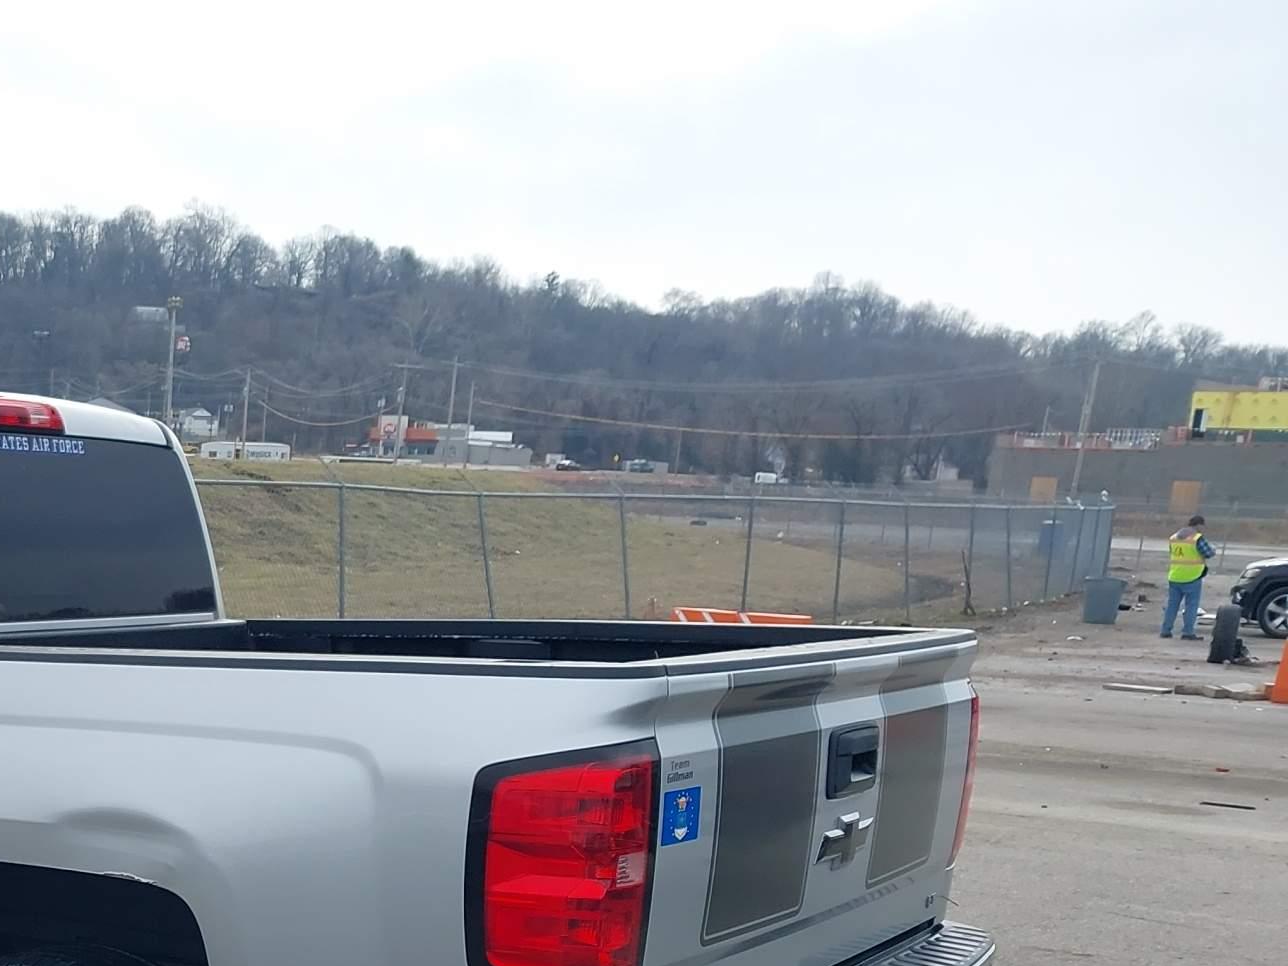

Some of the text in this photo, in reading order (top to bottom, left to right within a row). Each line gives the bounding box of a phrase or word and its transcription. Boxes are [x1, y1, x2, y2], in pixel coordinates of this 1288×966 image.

[32, 437, 51, 452] AIR
[53, 439, 86, 454] FORCE
[671, 760, 690, 772] Team
